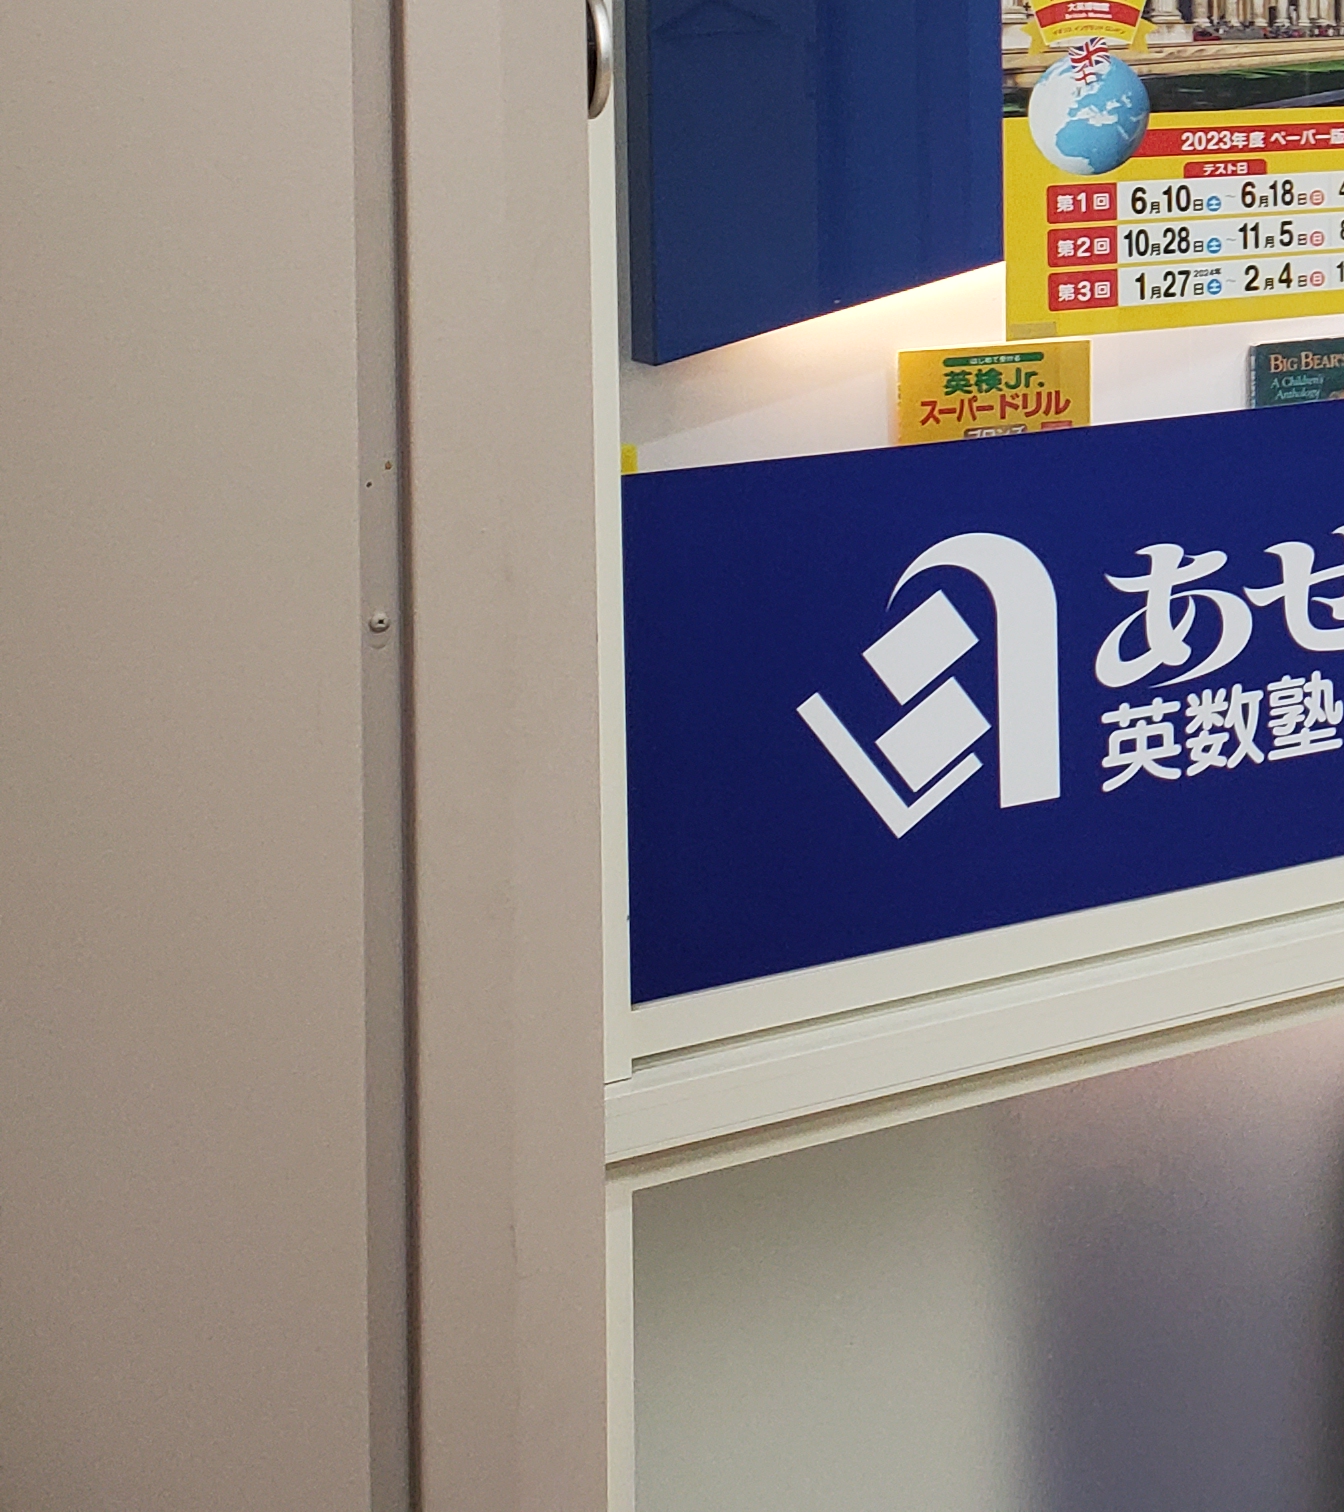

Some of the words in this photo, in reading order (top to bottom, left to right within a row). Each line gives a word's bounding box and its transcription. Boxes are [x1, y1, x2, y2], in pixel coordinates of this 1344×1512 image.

[1181, 130, 1266, 151] 2023年度
[1203, 163, 1248, 176] テスト日
[1056, 192, 1110, 213] 第1回
[1057, 237, 1110, 258] 第2回
[1057, 281, 1111, 302] 第3回
[943, 367, 1045, 396] 英検Jr.
[1270, 378, 1280, 389] A
[1275, 388, 1322, 402] Anthology
[920, 390, 1071, 426] スーパードリル
[1100, 672, 1344, 794] 英数塾
